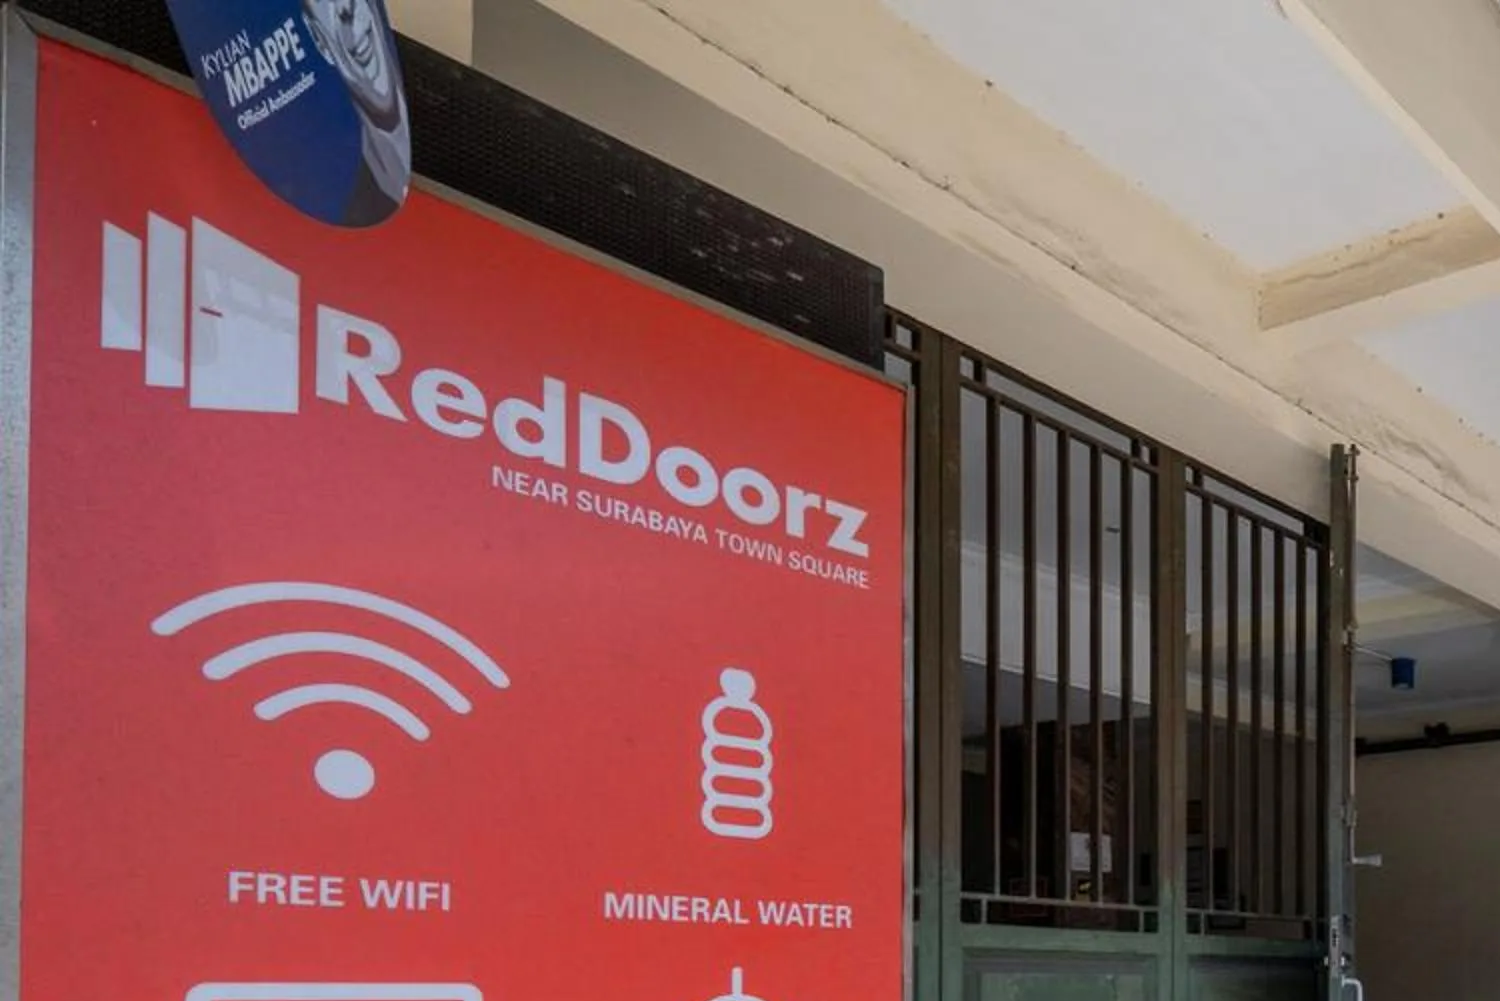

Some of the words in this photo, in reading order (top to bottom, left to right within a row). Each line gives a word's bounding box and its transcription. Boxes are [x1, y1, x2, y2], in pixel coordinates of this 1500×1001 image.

[201, 28, 251, 80] KYLIAN
[237, 99, 271, 130] Official
[315, 303, 870, 558] RedDoorz
[492, 465, 568, 506] NEAR
[576, 489, 708, 545] SURABAYA
[715, 528, 783, 566] TOWN
[788, 551, 870, 589] SQUARE
[228, 871, 345, 907] FREE
[359, 878, 451, 911] WIFI
[604, 891, 750, 925] MINERAL
[757, 900, 853, 929] WATER
